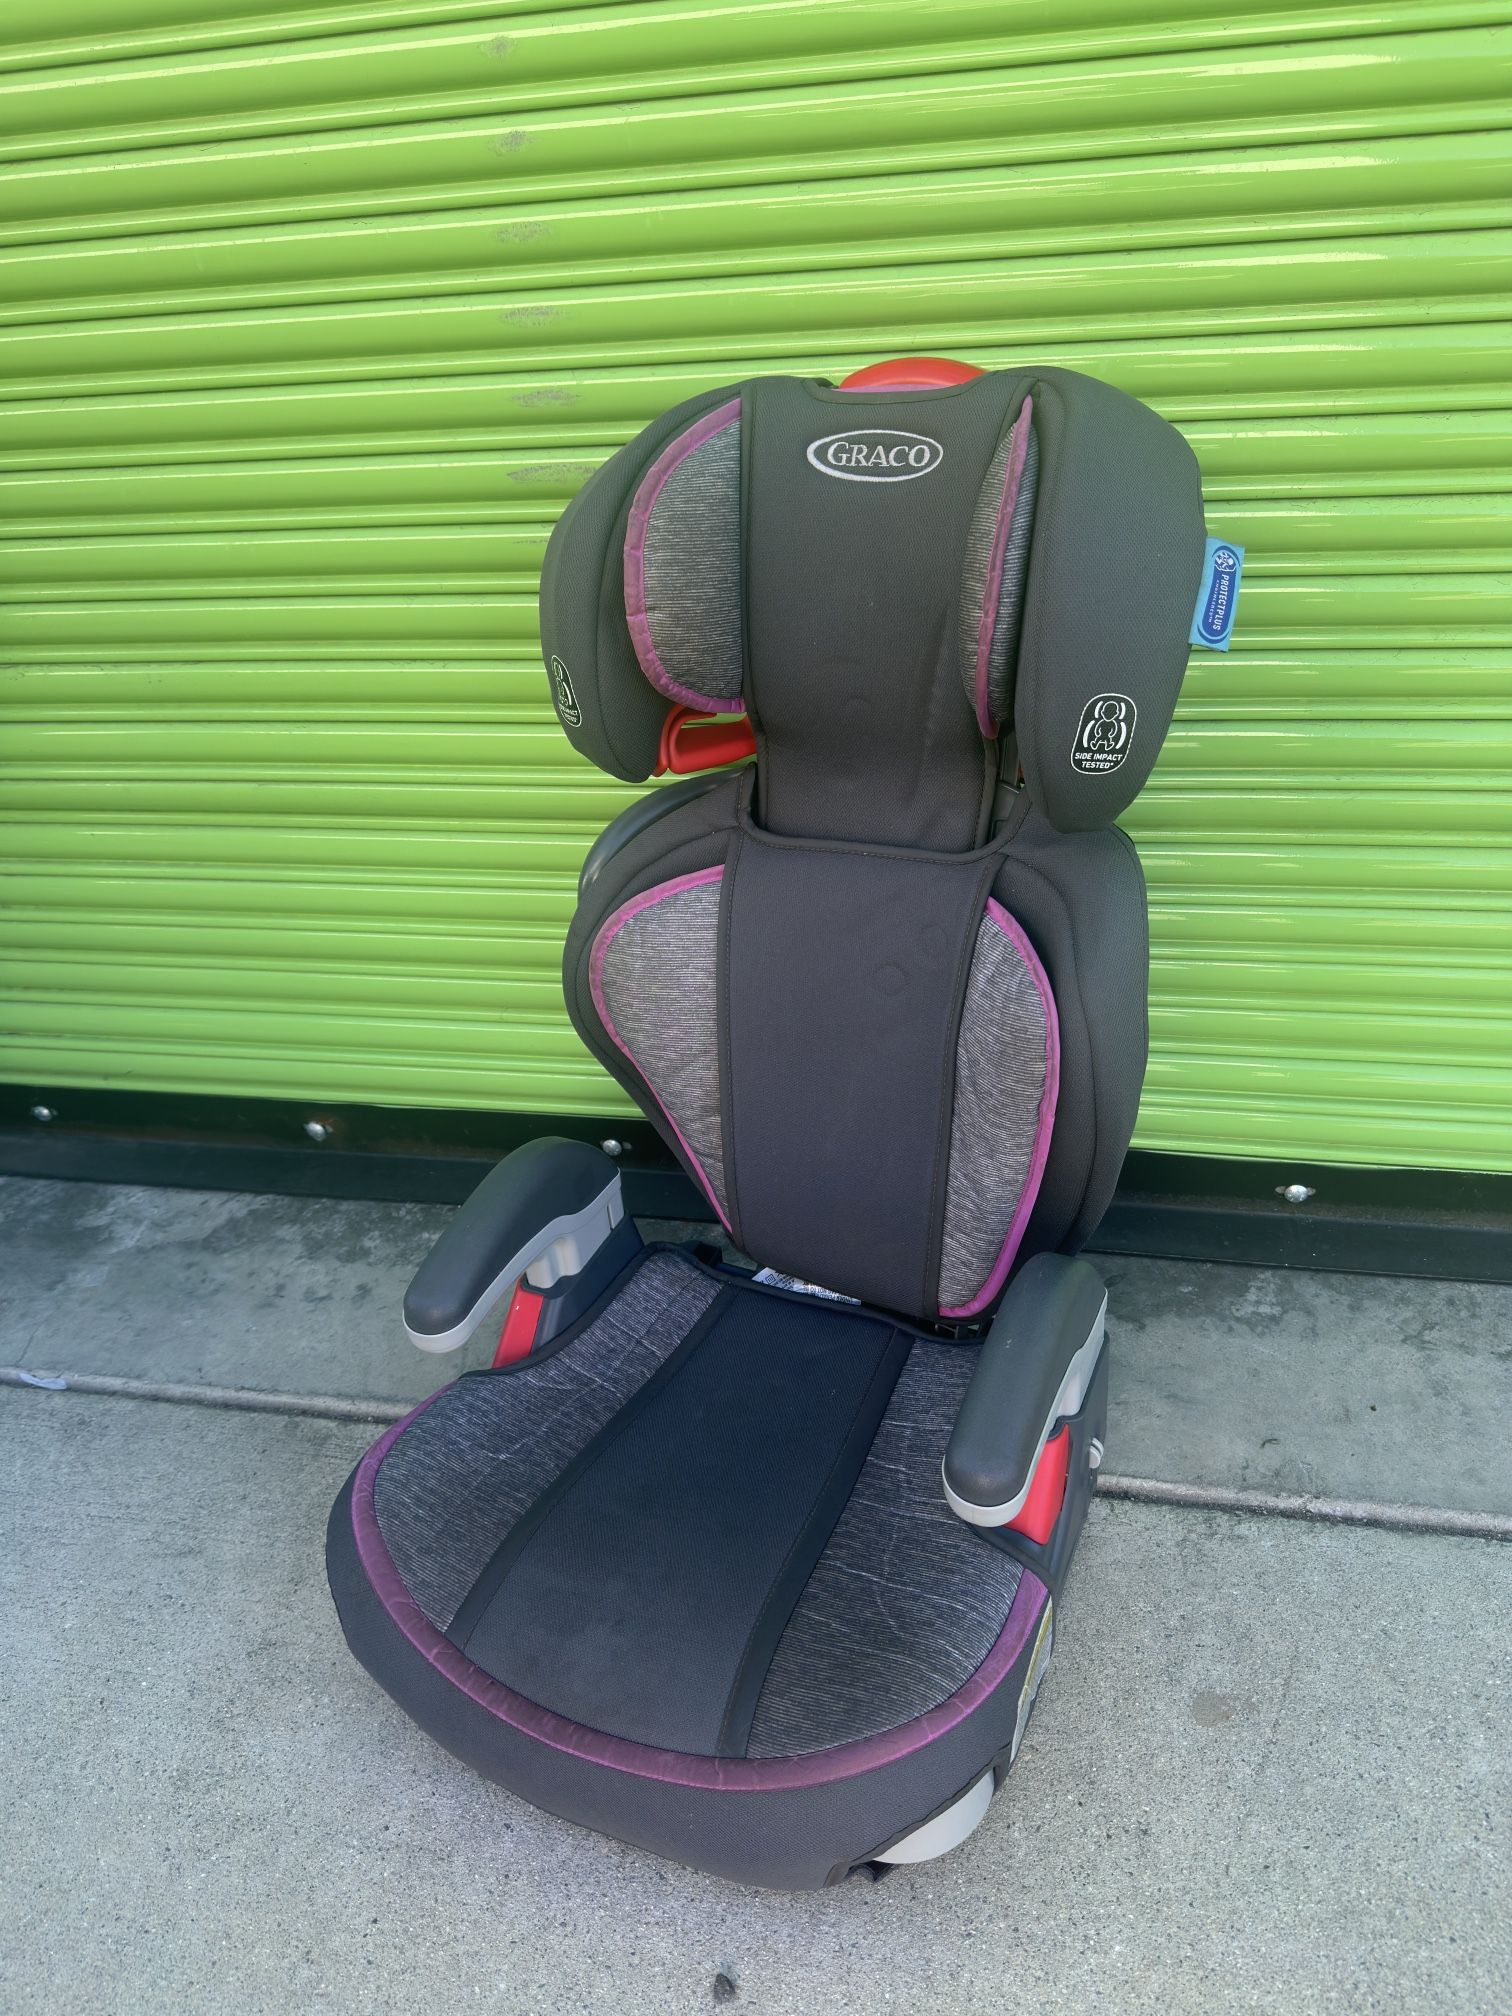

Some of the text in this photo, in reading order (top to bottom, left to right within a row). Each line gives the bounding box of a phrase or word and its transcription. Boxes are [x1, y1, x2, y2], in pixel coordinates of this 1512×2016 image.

[827, 441, 931, 467] GRACO
[1212, 574, 1229, 631] PROTECTPLUS
[1074, 752, 1123, 761] SIDE IMPACT
